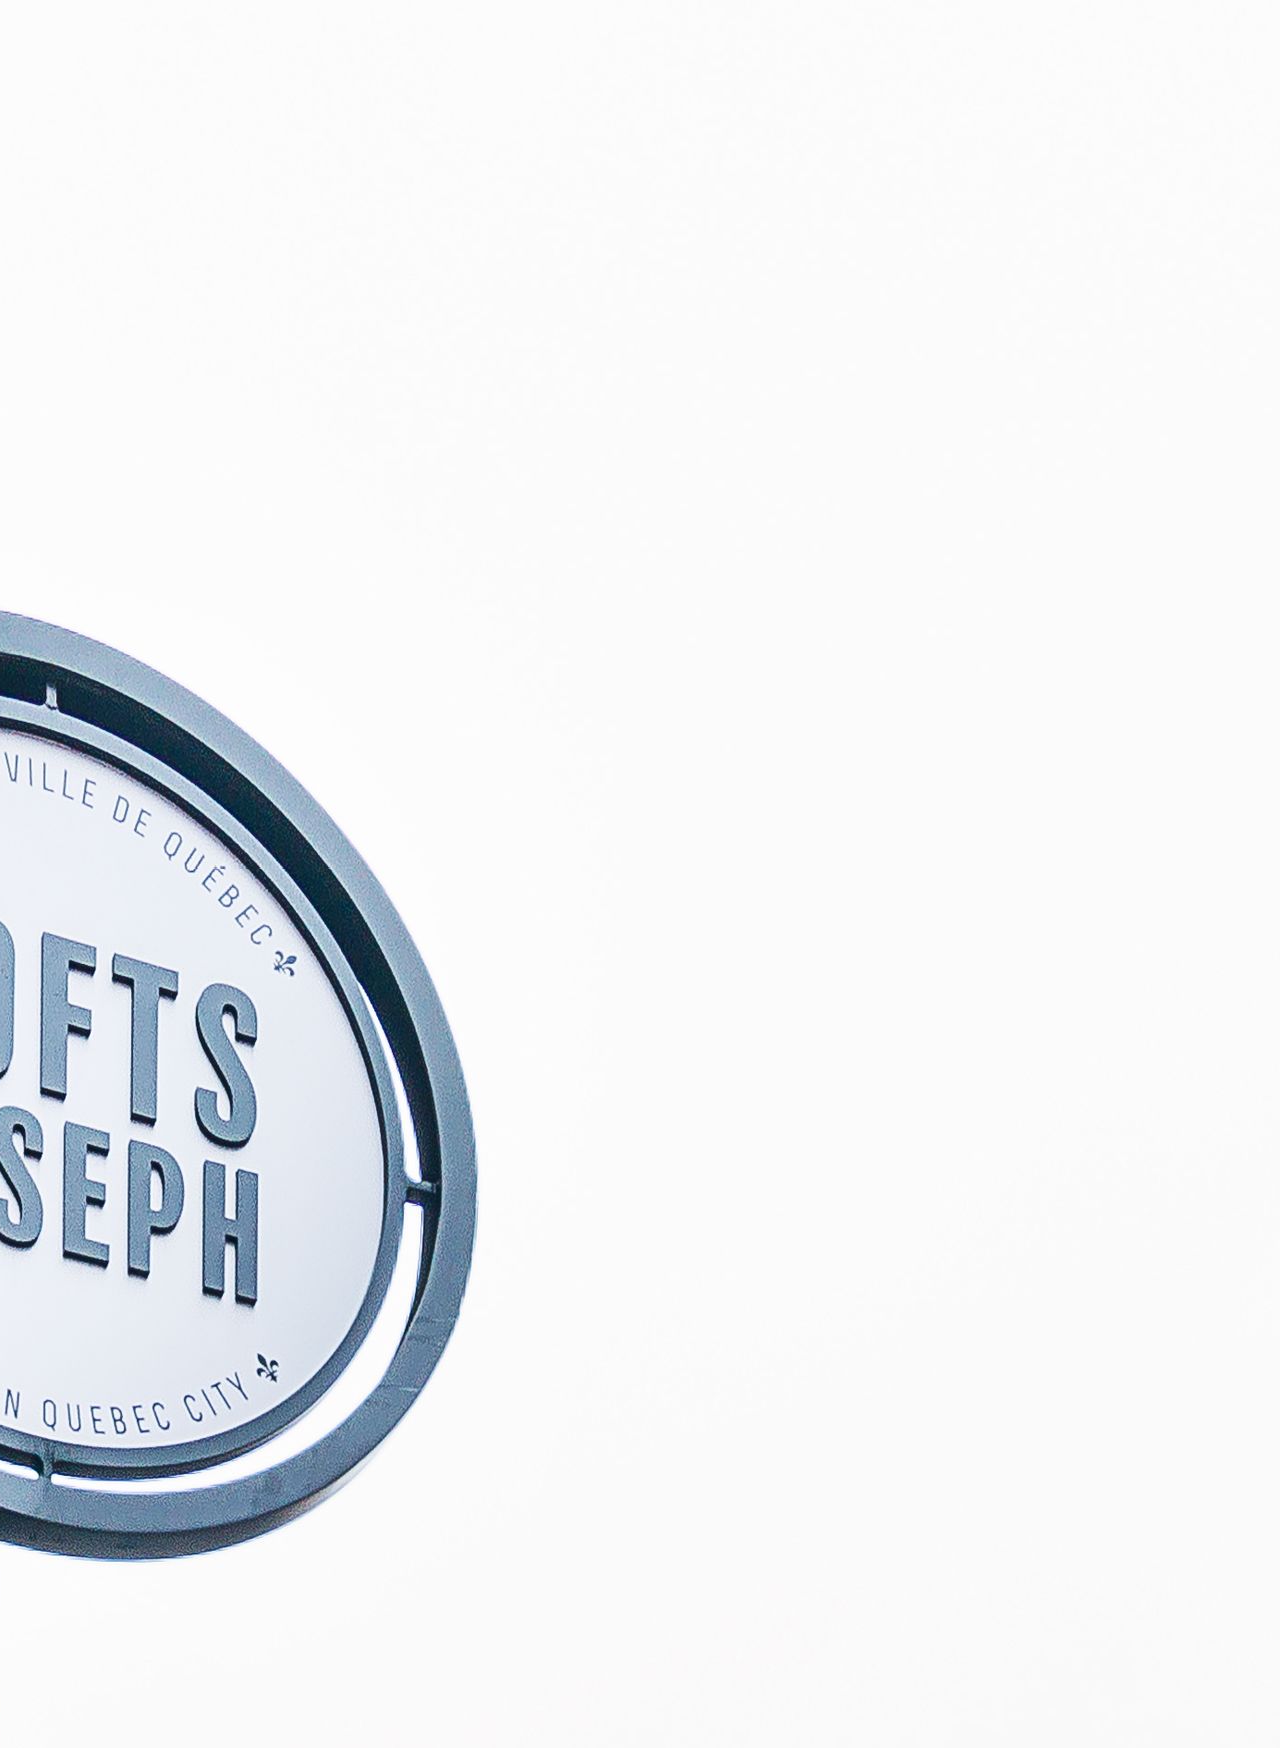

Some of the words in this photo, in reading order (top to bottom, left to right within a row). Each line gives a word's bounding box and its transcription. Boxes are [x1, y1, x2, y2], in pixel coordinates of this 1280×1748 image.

[112, 795, 152, 837] DE
[163, 831, 273, 945] QUÉBEC
[42, 1399, 171, 1435] QUEBEC
[183, 1371, 250, 1423] CITY
